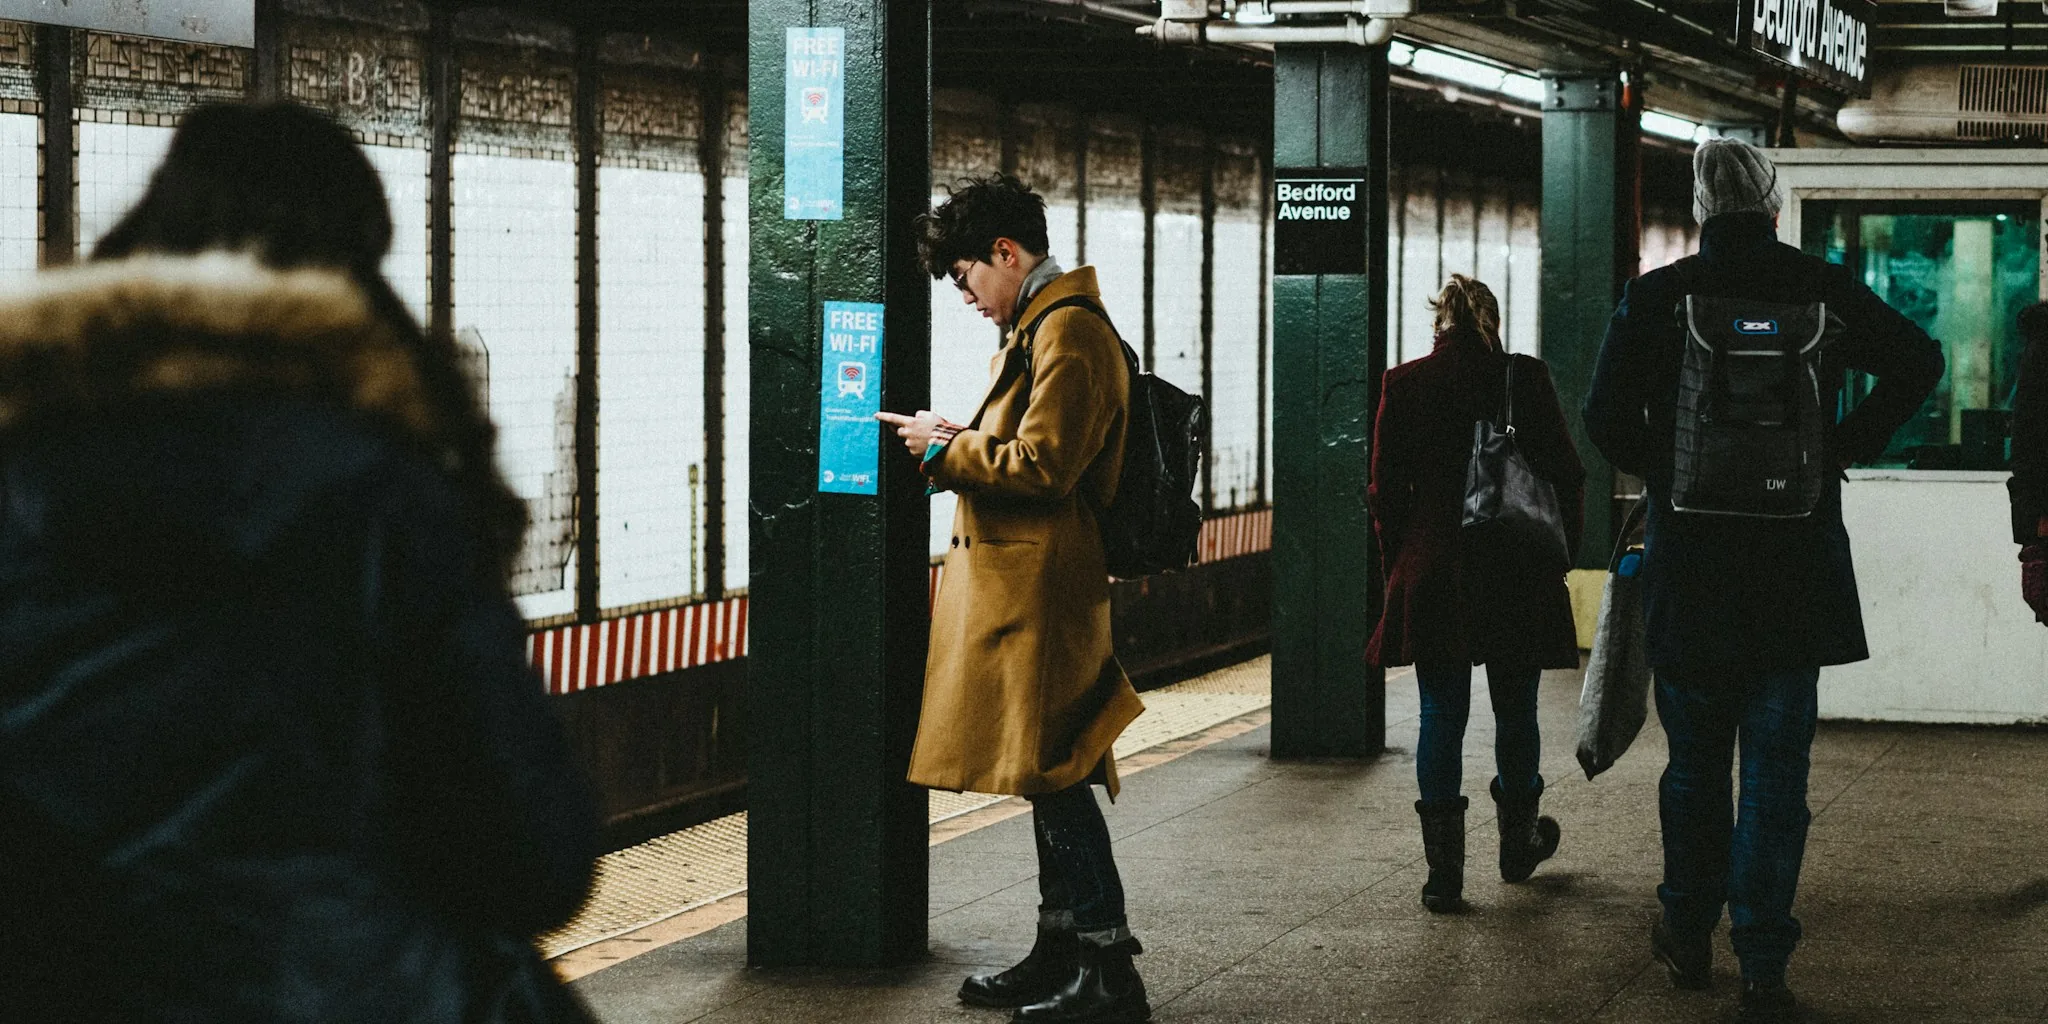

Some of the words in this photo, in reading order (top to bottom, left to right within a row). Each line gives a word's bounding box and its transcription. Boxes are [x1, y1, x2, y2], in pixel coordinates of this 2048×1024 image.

[792, 36, 840, 56] FREE
[1818, 0, 1867, 82] Avenue
[792, 58, 839, 78] WI-FI
[1277, 183, 1356, 202] Bedford
[1277, 202, 1351, 220] Avenue
[830, 310, 878, 331] FREE
[829, 332, 876, 354] WI-FI
[1766, 479, 1786, 490] TJW
